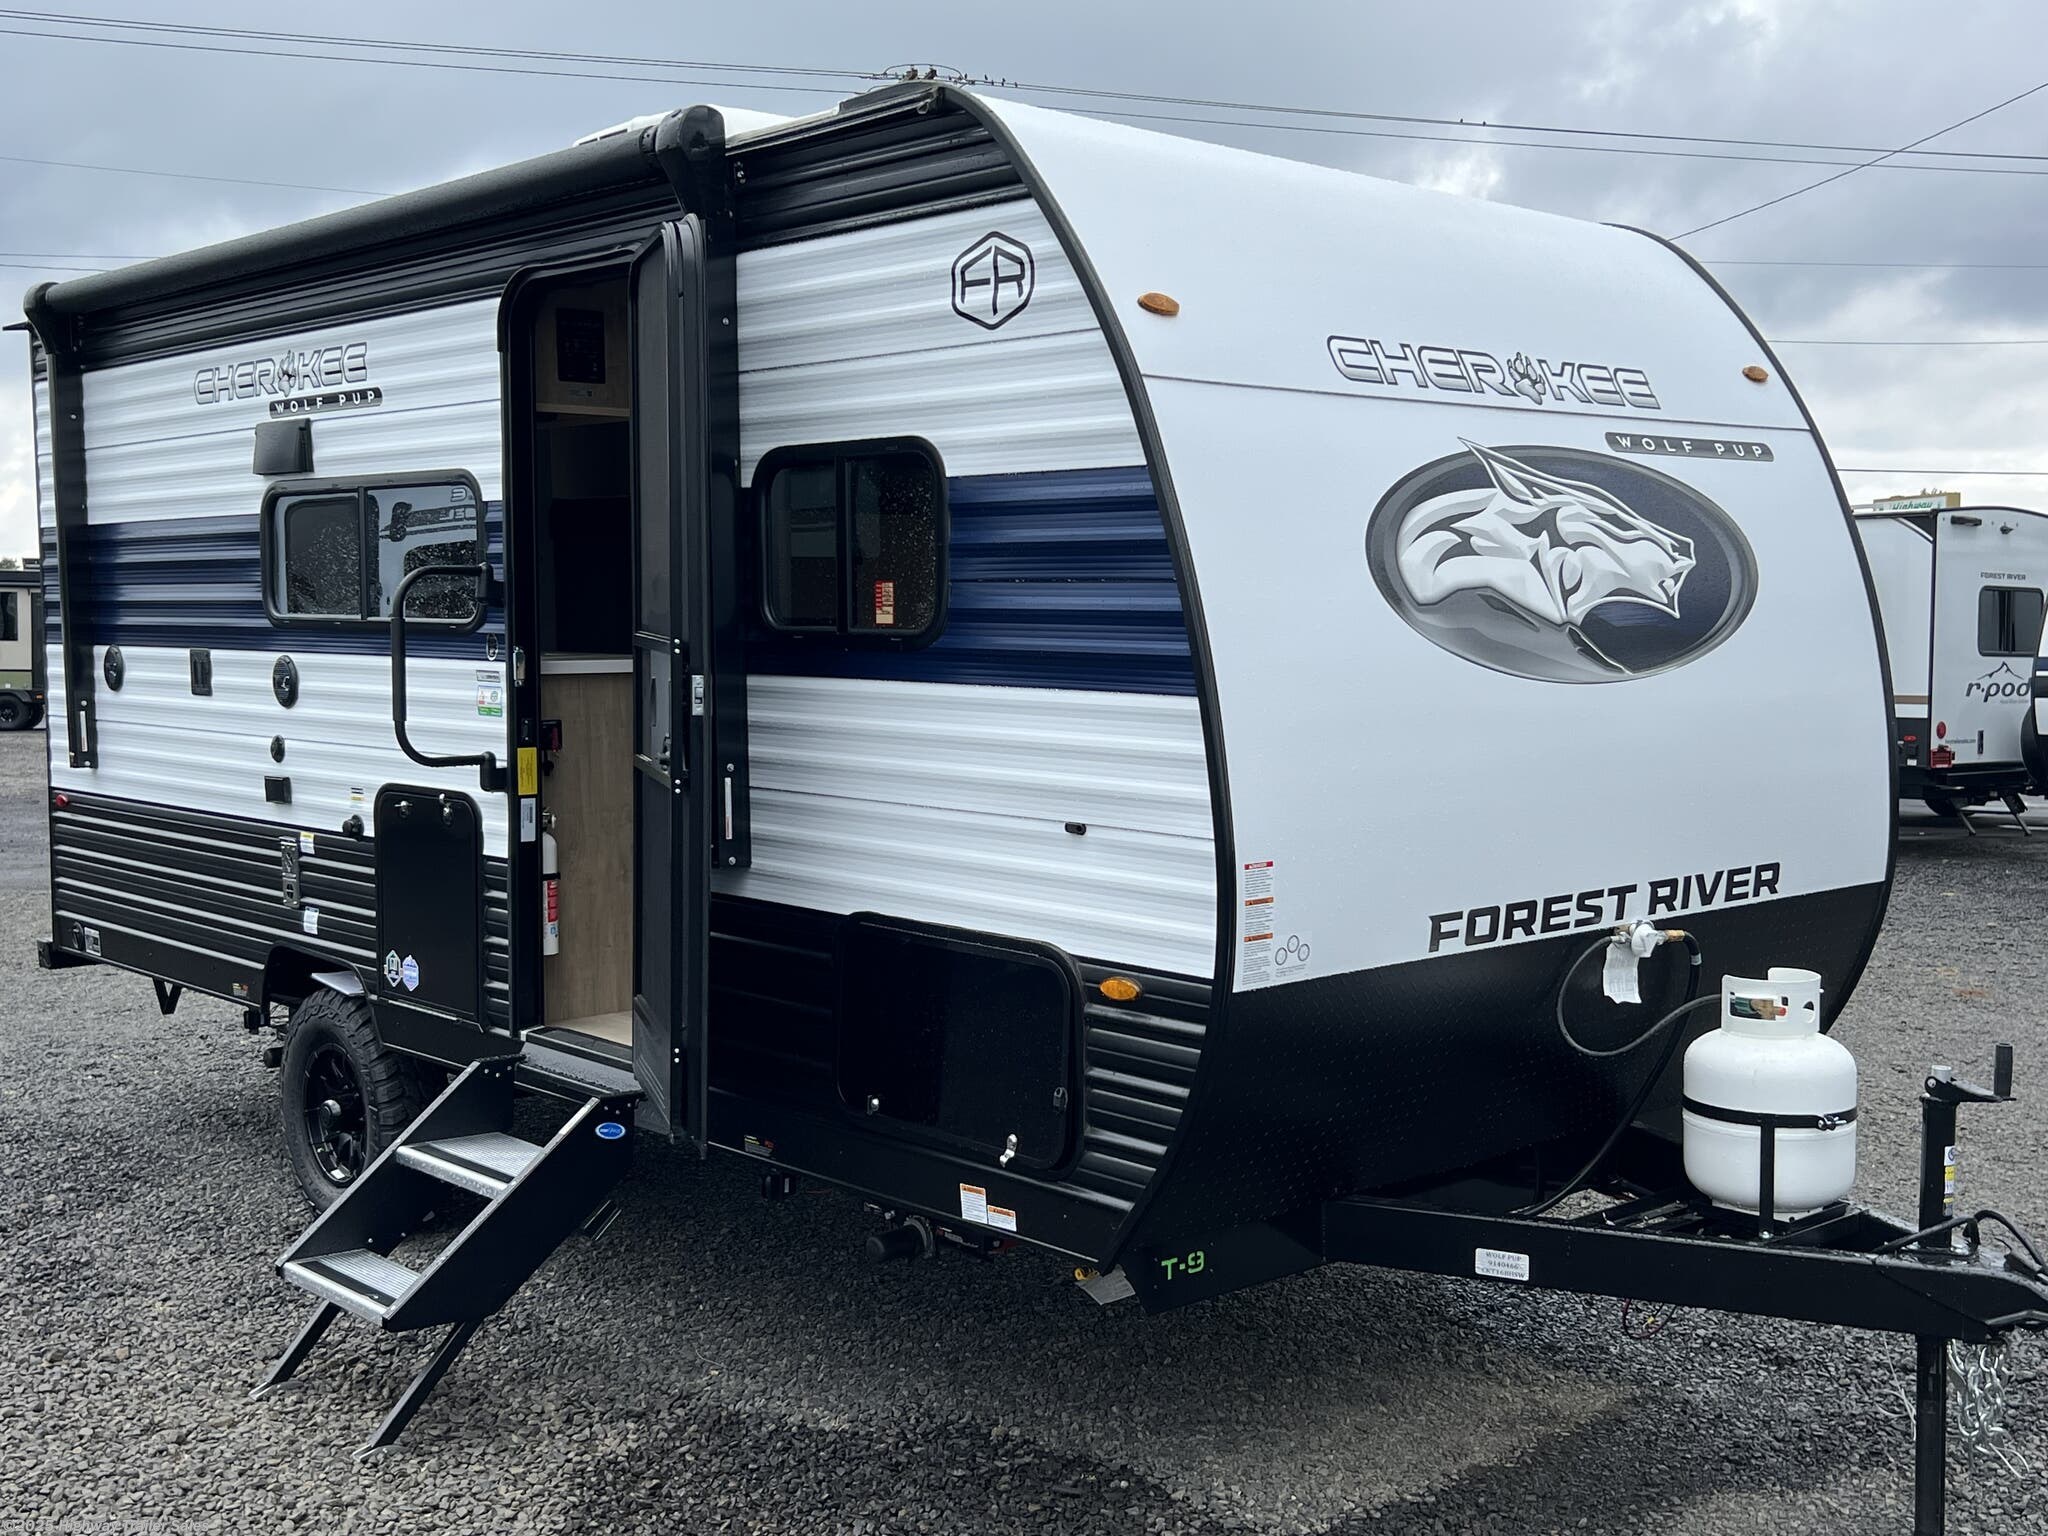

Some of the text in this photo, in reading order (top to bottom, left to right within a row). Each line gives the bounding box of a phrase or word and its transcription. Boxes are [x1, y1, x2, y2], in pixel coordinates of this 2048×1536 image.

[274, 391, 375, 415] WOLF PUP
[1616, 435, 1763, 457] WOLF PUP
[1427, 862, 1781, 953] FOREST RIVER
[1161, 1250, 1205, 1281] T-9
